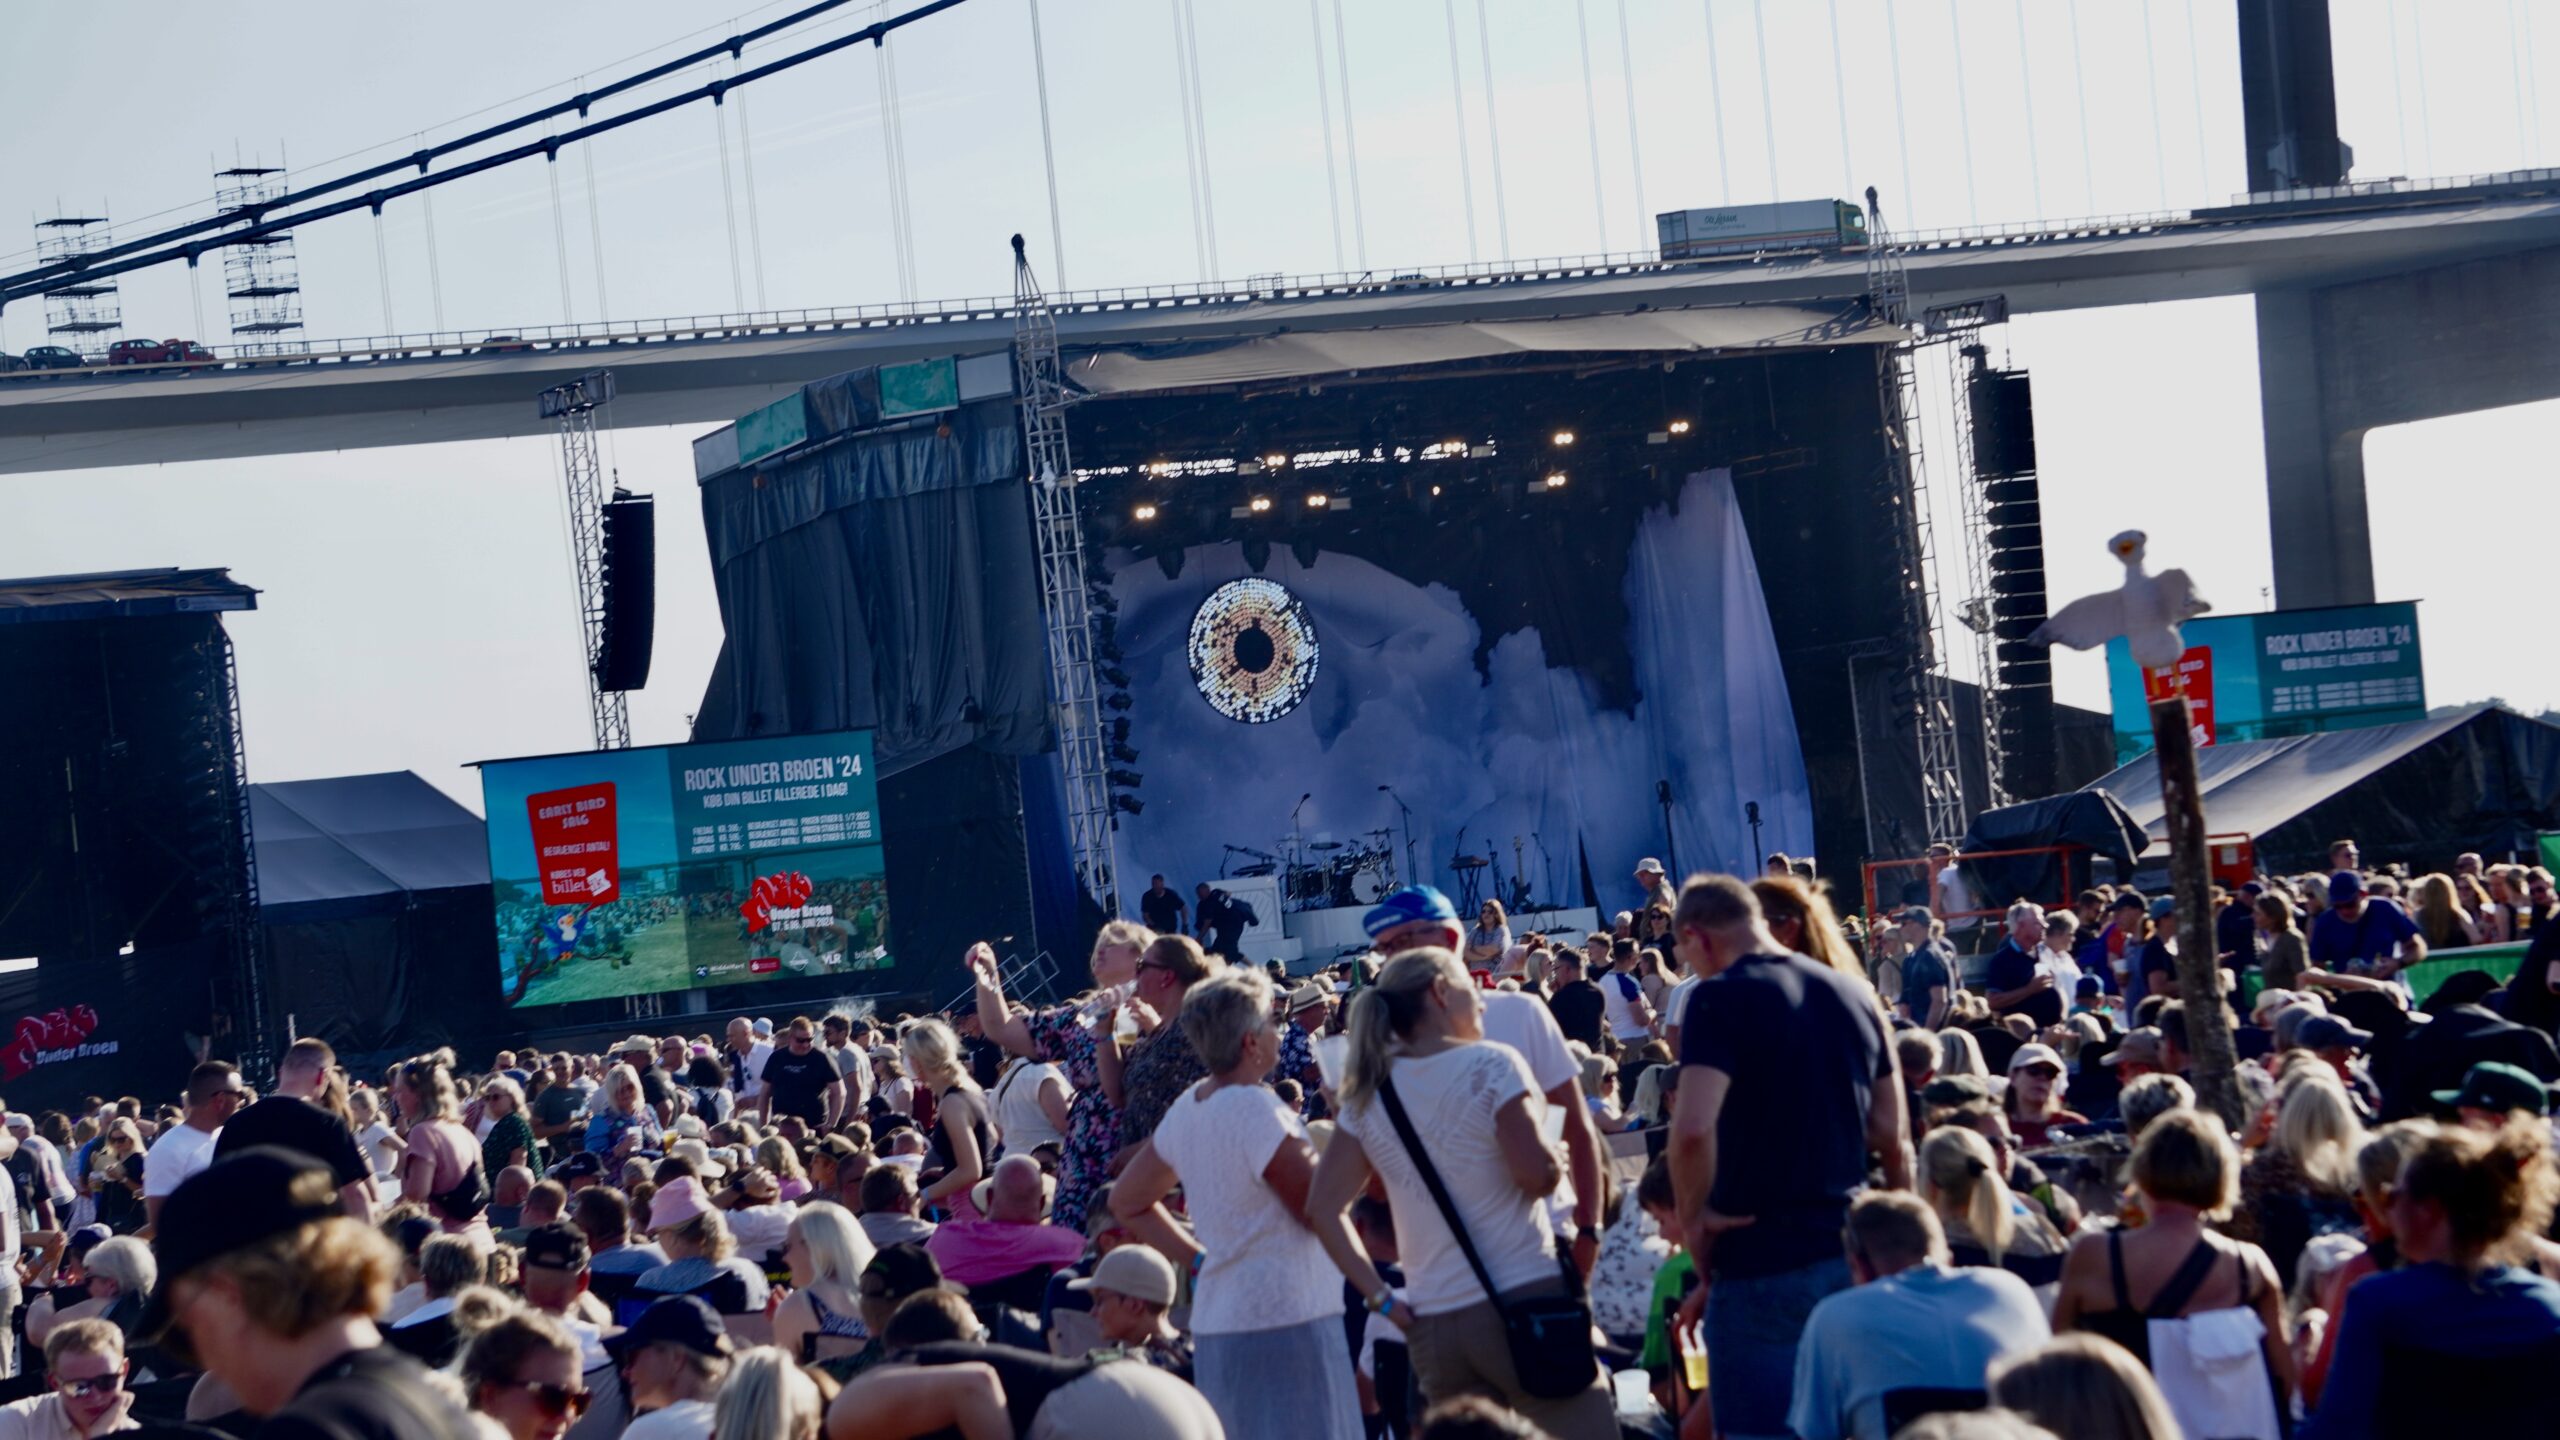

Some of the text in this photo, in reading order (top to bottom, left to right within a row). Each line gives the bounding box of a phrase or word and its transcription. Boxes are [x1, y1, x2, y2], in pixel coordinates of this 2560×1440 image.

[2266, 634, 2300, 655] ROCK
[2301, 630, 2344, 652] UNDER
[2345, 626, 2388, 649] BROEN
[684, 765, 727, 791] ROCK
[728, 761, 780, 787] UNDER
[783, 757, 834, 783] BROEN
[724, 791, 741, 807] DIN
[742, 788, 773, 805] BILLET
[774, 784, 820, 802] ALLEREDE
[538, 797, 606, 819] EARLY BIRD
[562, 813, 589, 829] SALG
[770, 904, 833, 921] Under Broen
[36, 1040, 119, 1065] Under Broen
